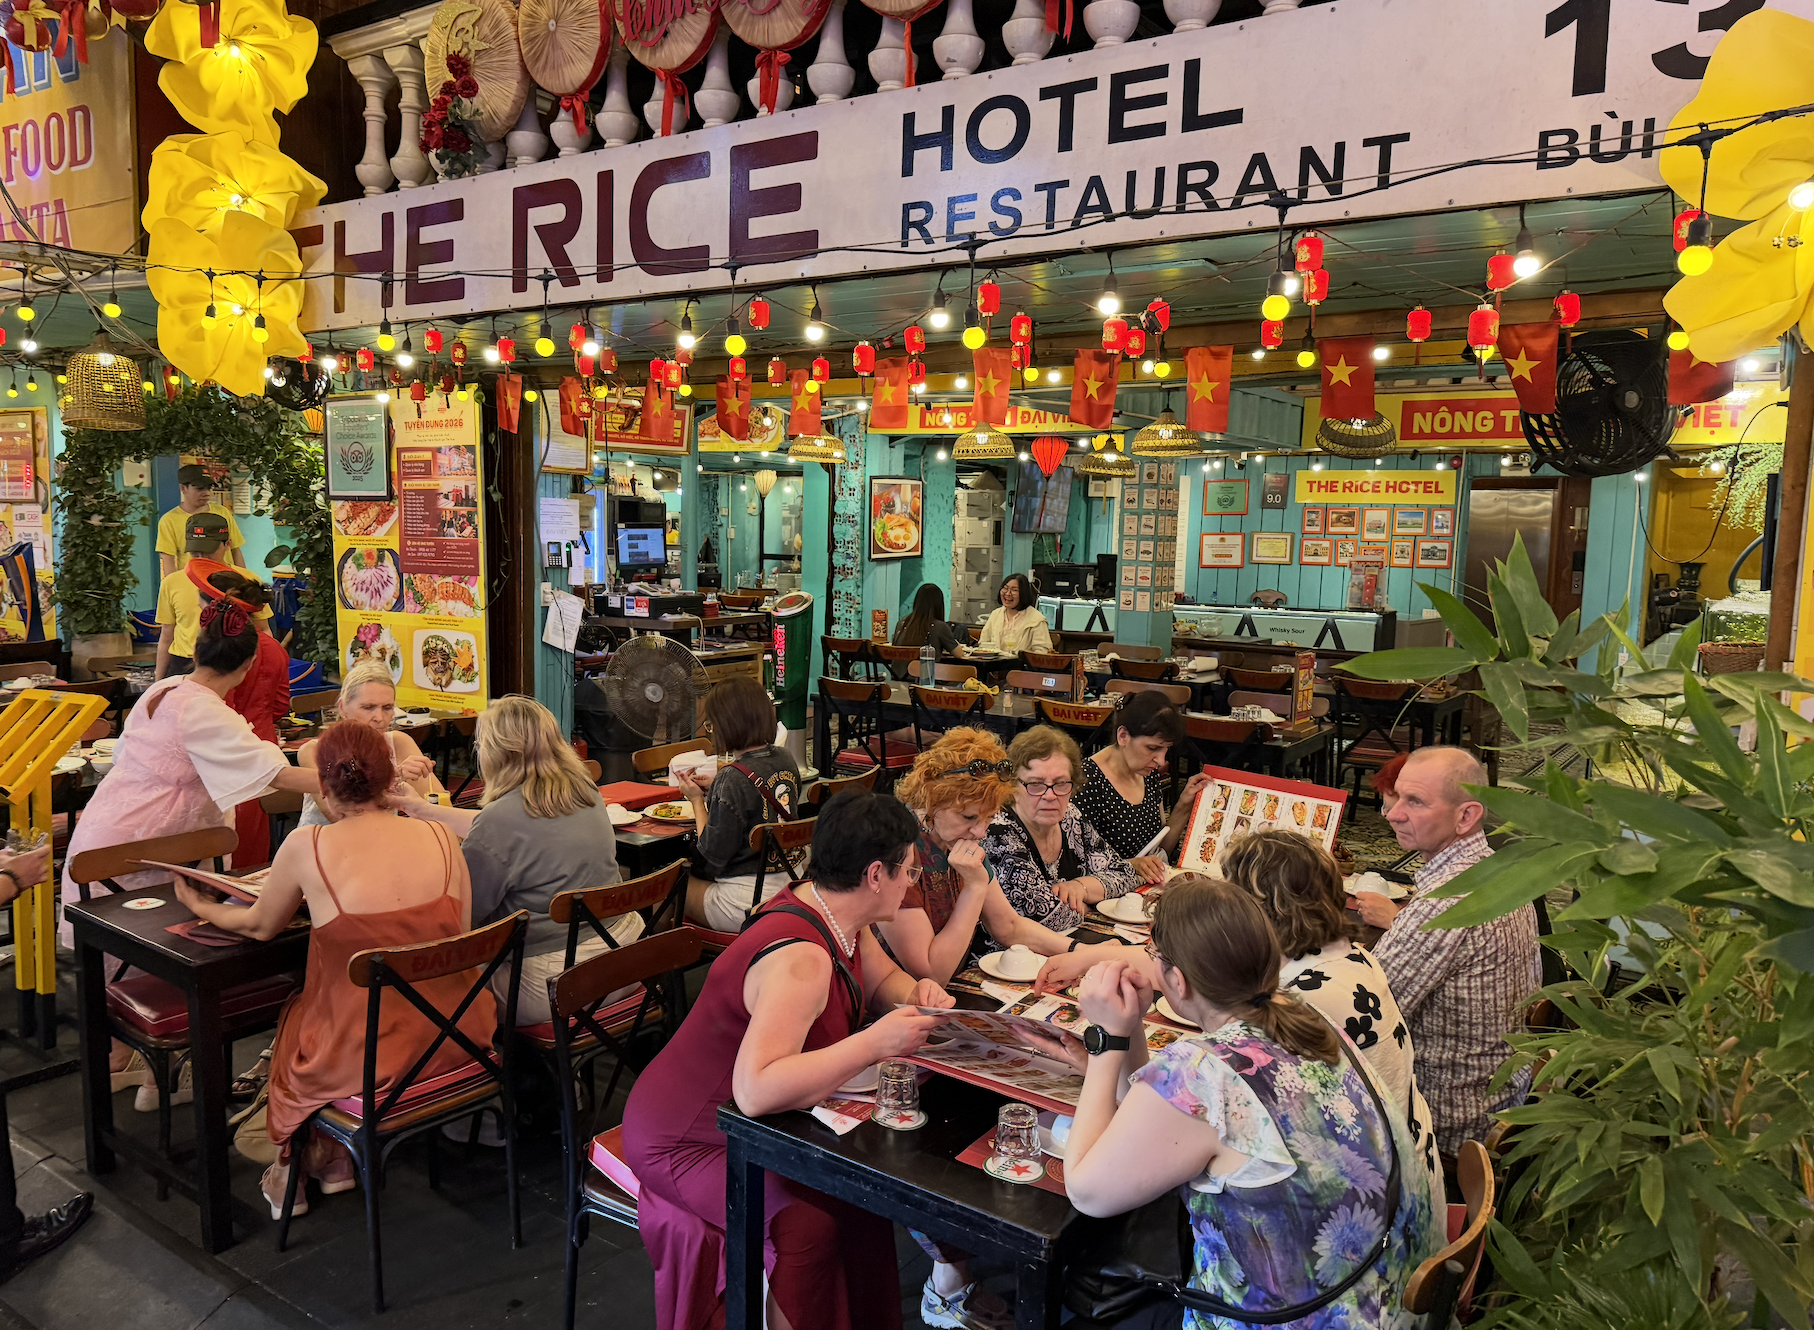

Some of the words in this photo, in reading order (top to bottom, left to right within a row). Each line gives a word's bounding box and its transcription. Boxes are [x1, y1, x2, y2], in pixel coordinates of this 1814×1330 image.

[1536, 110, 1656, 171] BÙI
[511, 130, 819, 294] RICE
[901, 57, 1244, 178] HOTEL
[901, 132, 1411, 248] RESTAURANT
[1020, 411, 1047, 428] ĐẠI
[1412, 405, 1495, 434] NÔNG
[1267, 494, 1281, 503] 9.0
[1306, 480, 1339, 493] THE
[1385, 480, 1444, 494] HOTEL
[774, 624, 785, 687] Heineken
